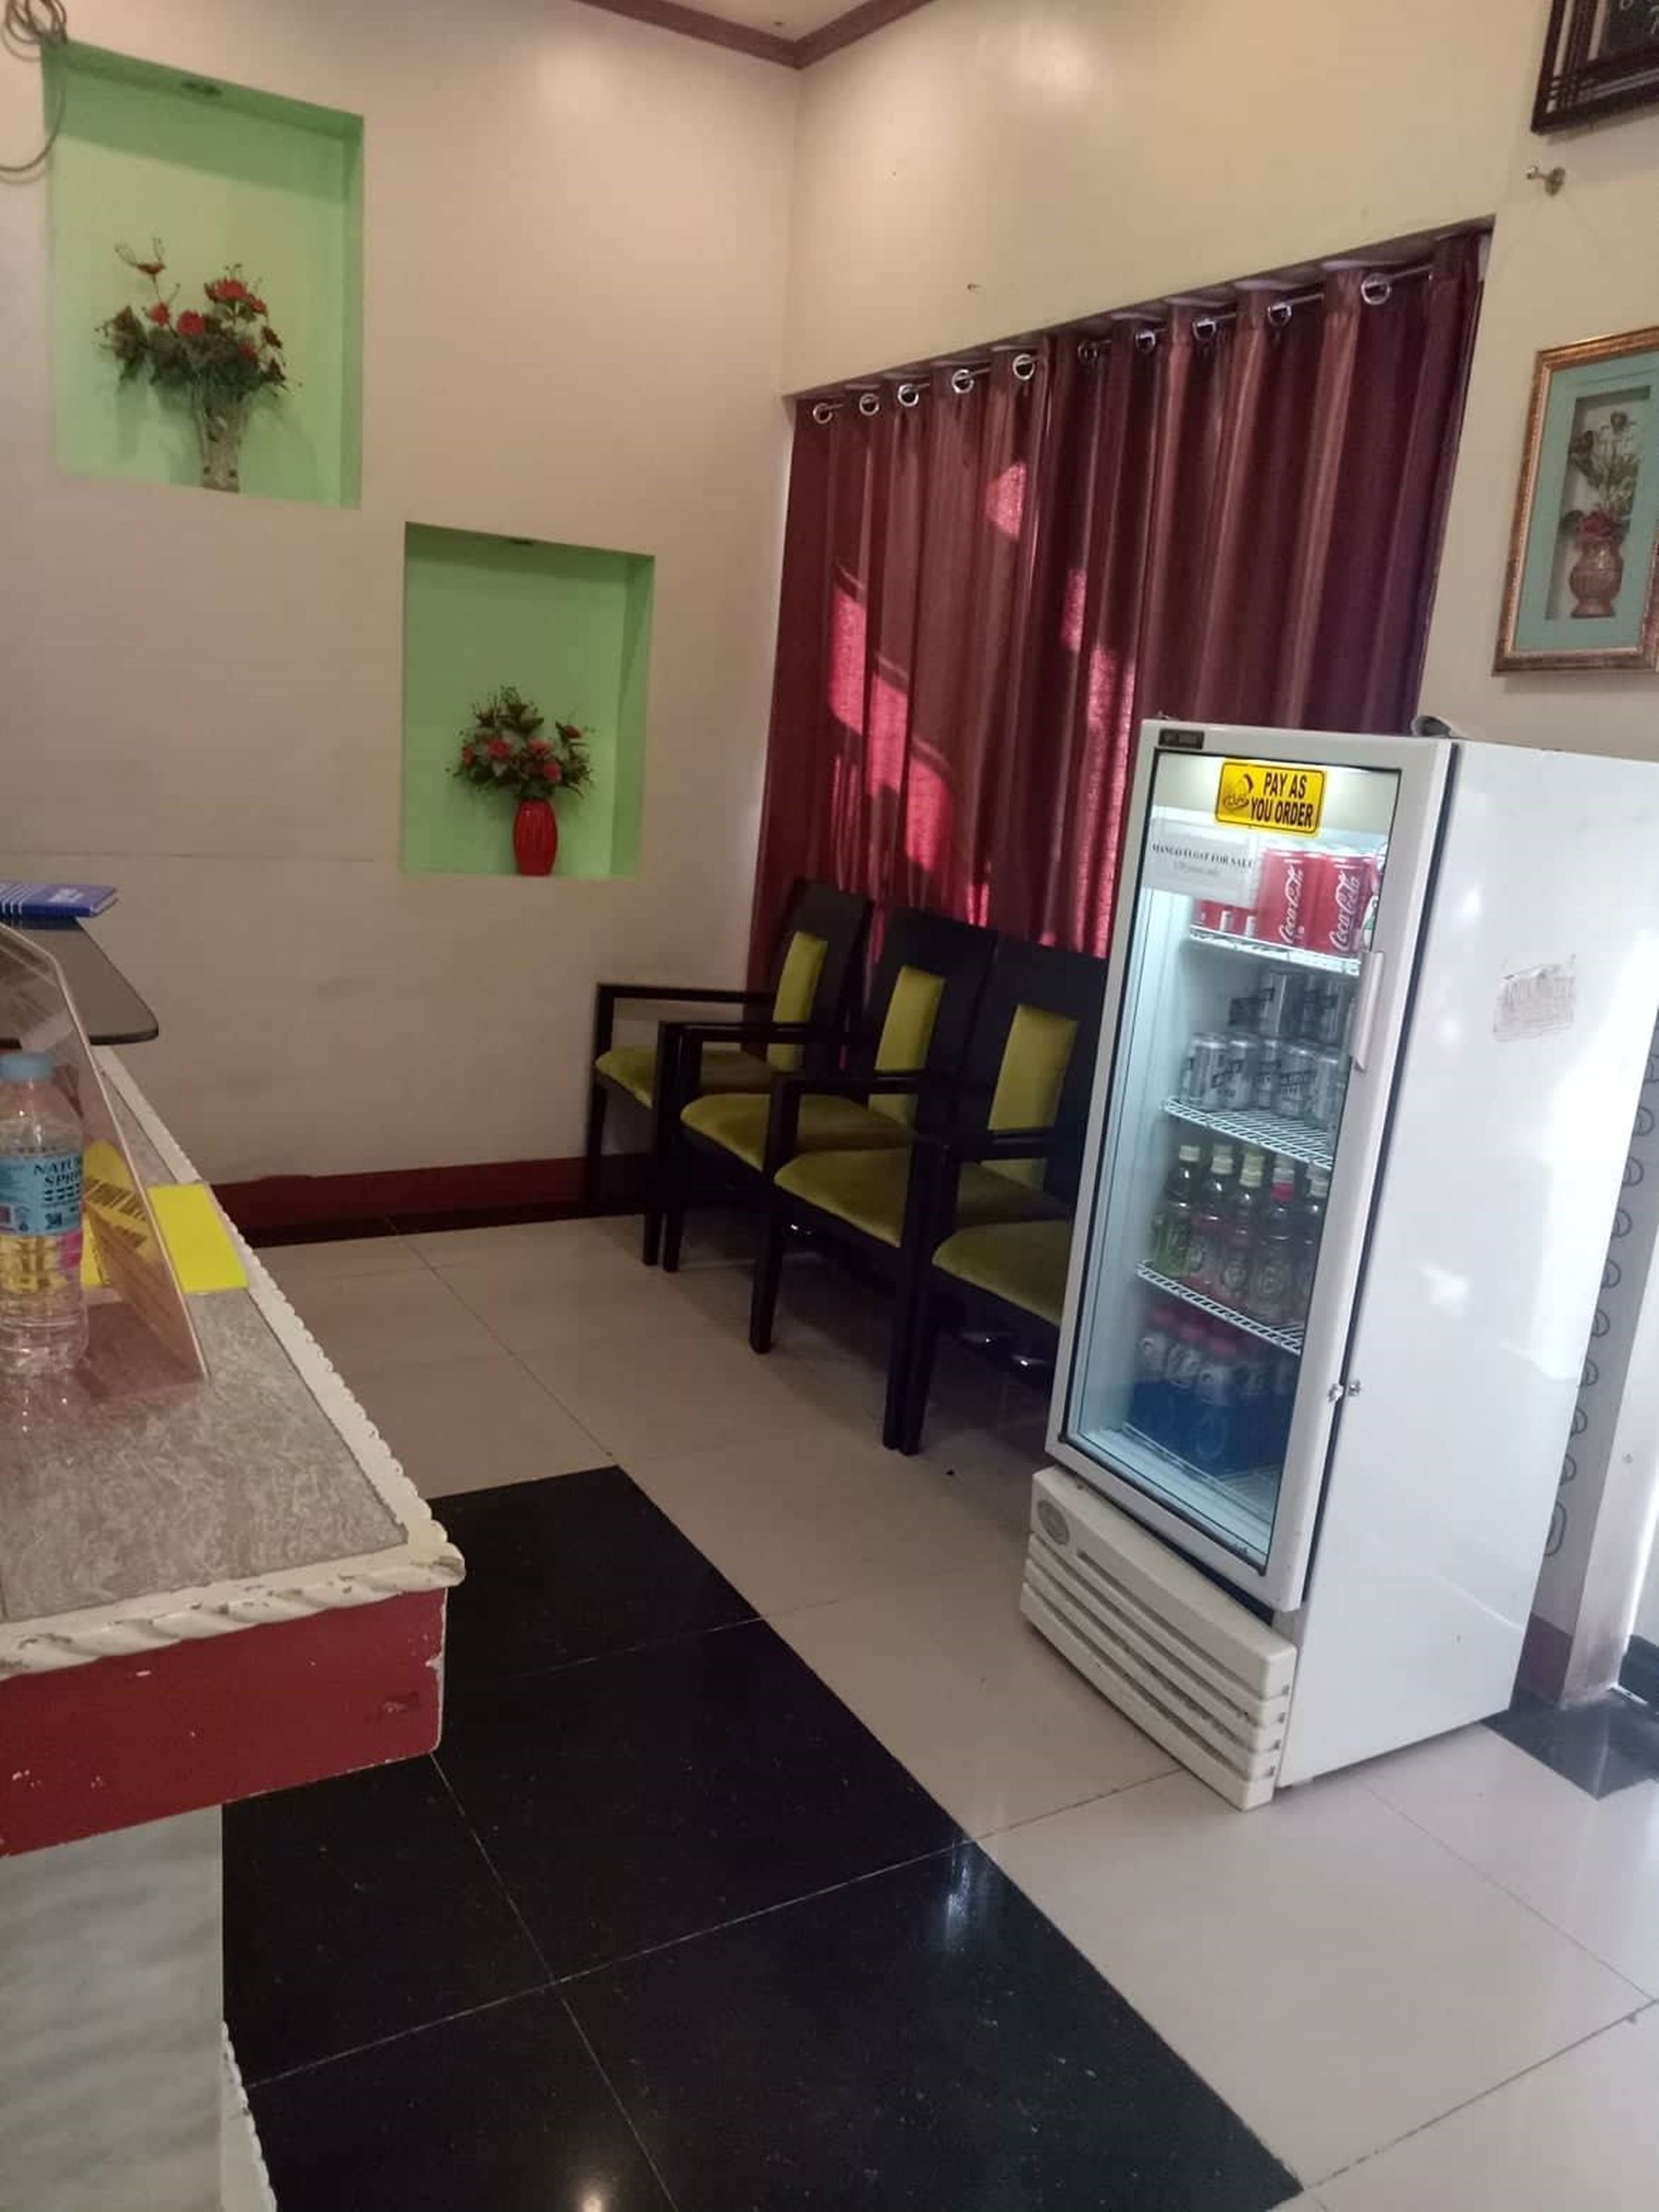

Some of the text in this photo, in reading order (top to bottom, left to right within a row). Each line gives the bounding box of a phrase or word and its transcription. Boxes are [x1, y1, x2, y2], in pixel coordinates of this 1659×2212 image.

[1263, 772, 1307, 799] PAY AS
[1250, 796, 1313, 828] YOU ORDER
[1211, 854, 1229, 865] FOR
